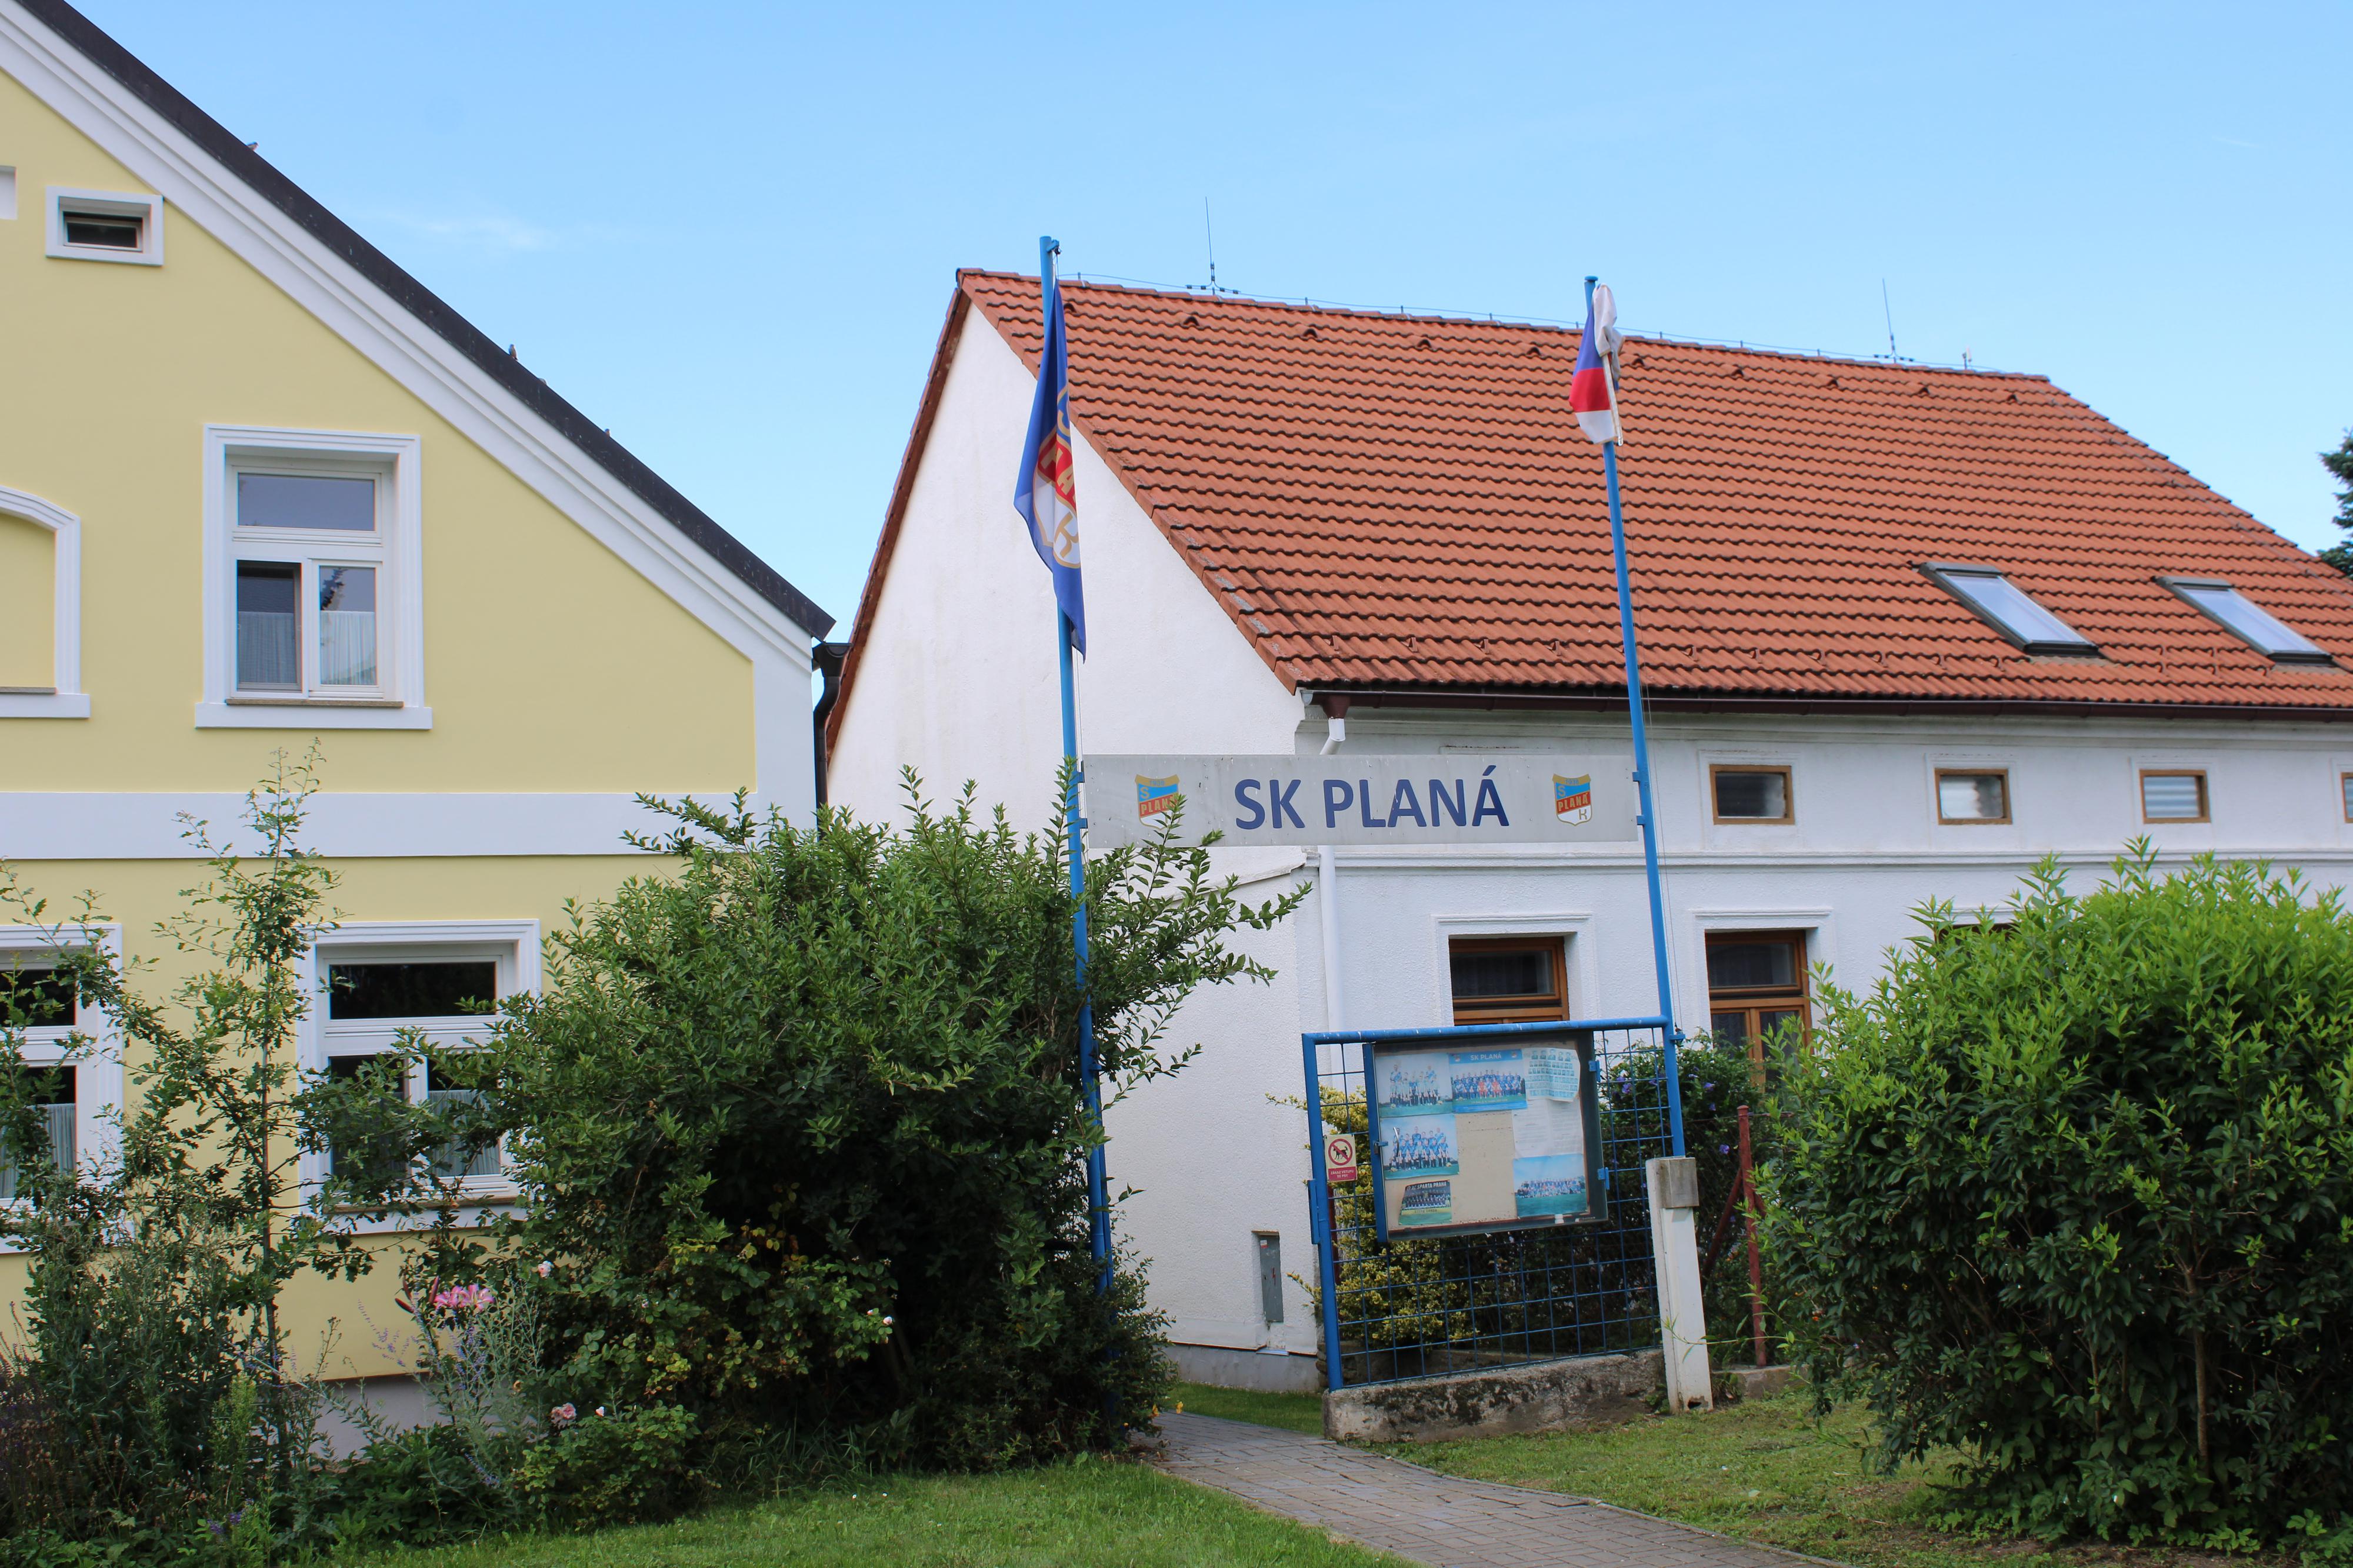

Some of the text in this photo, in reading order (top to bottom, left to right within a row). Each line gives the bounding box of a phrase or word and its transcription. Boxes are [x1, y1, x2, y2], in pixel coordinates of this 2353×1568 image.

[1140, 786, 1150, 799] S
[1234, 764, 1511, 830] SK PLANÁ
[1557, 785, 1566, 797] S
[1558, 792, 1588, 812] PLANÁ
[1578, 809, 1588, 820] K
[1480, 1052, 1502, 1060] PLANÁ
